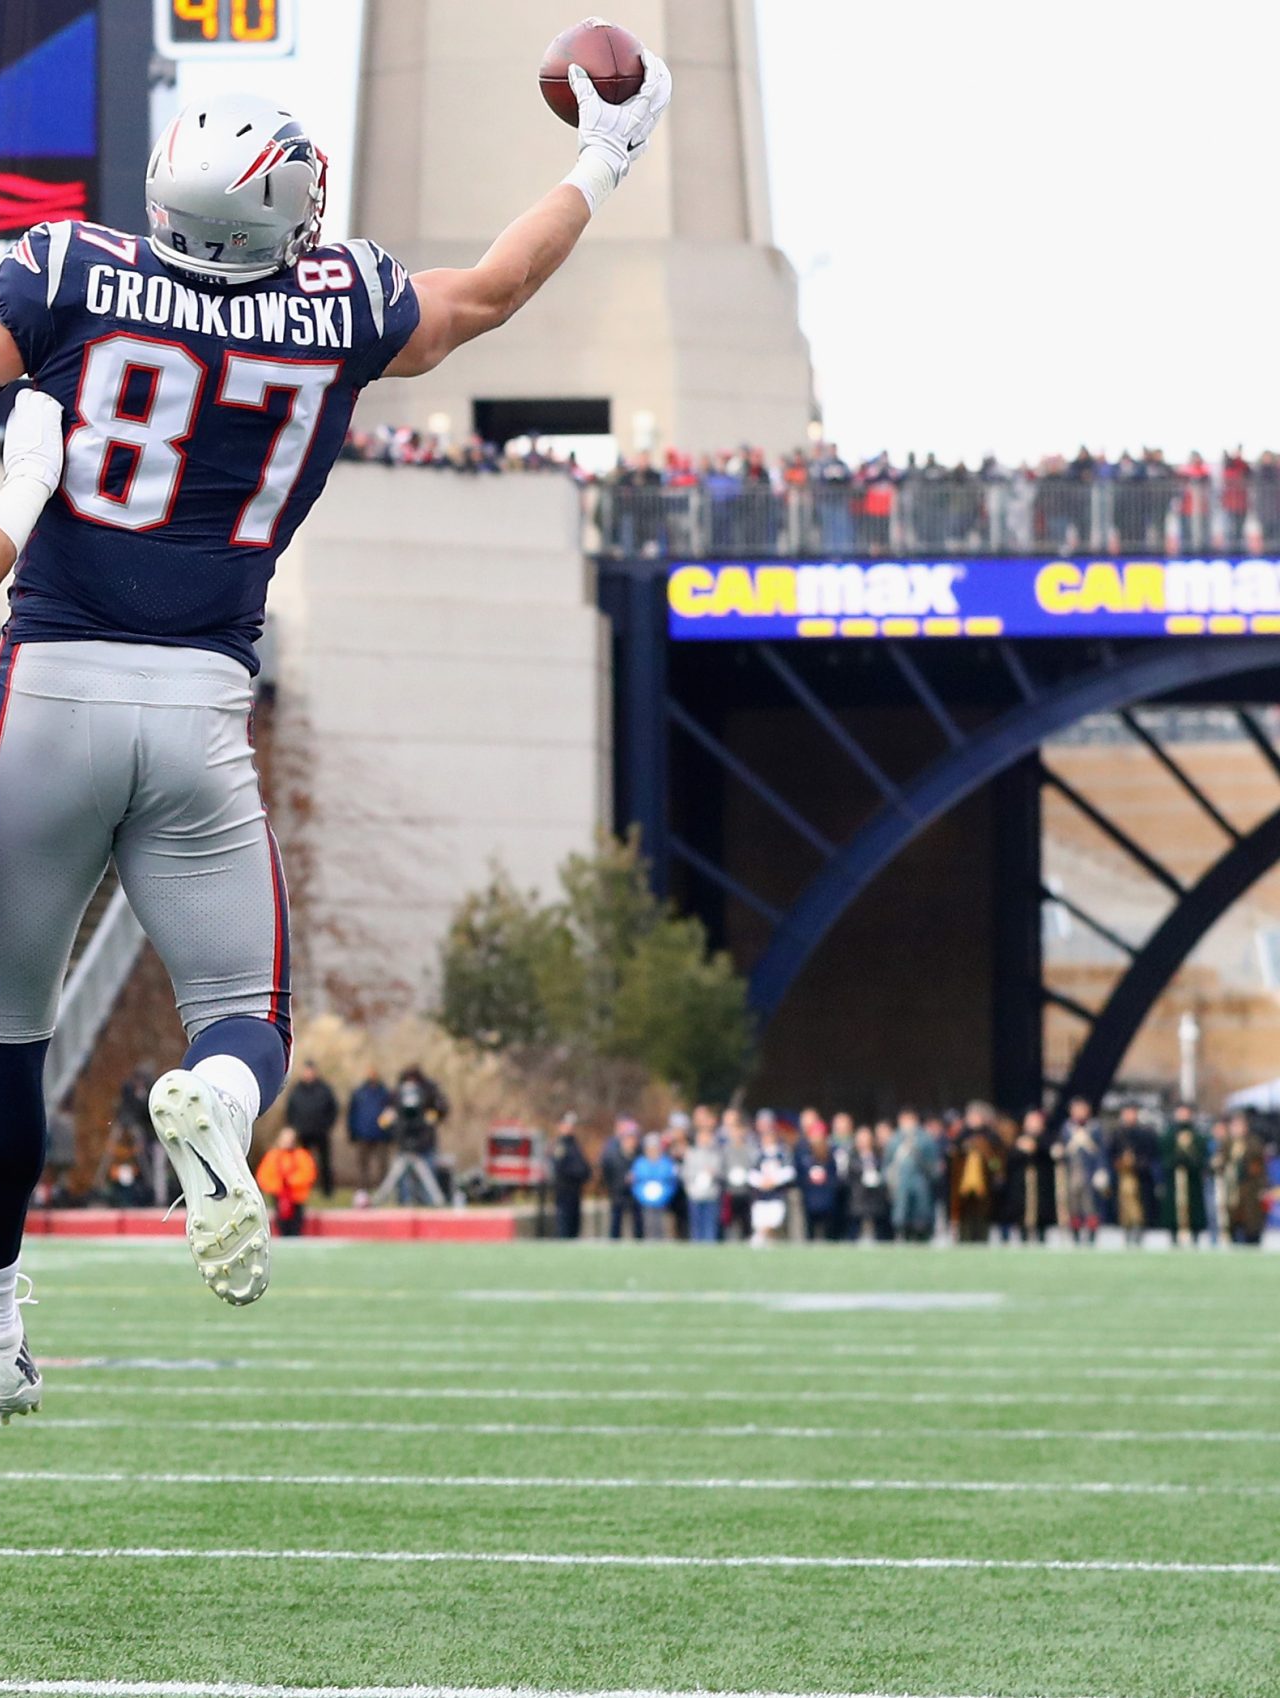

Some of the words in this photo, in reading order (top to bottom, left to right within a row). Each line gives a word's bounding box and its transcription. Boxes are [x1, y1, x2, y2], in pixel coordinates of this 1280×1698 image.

[77, 221, 138, 266] 7
[296, 246, 356, 295] 8
[86, 264, 353, 349] GRONKOWSKI
[60, 330, 345, 549] 87
